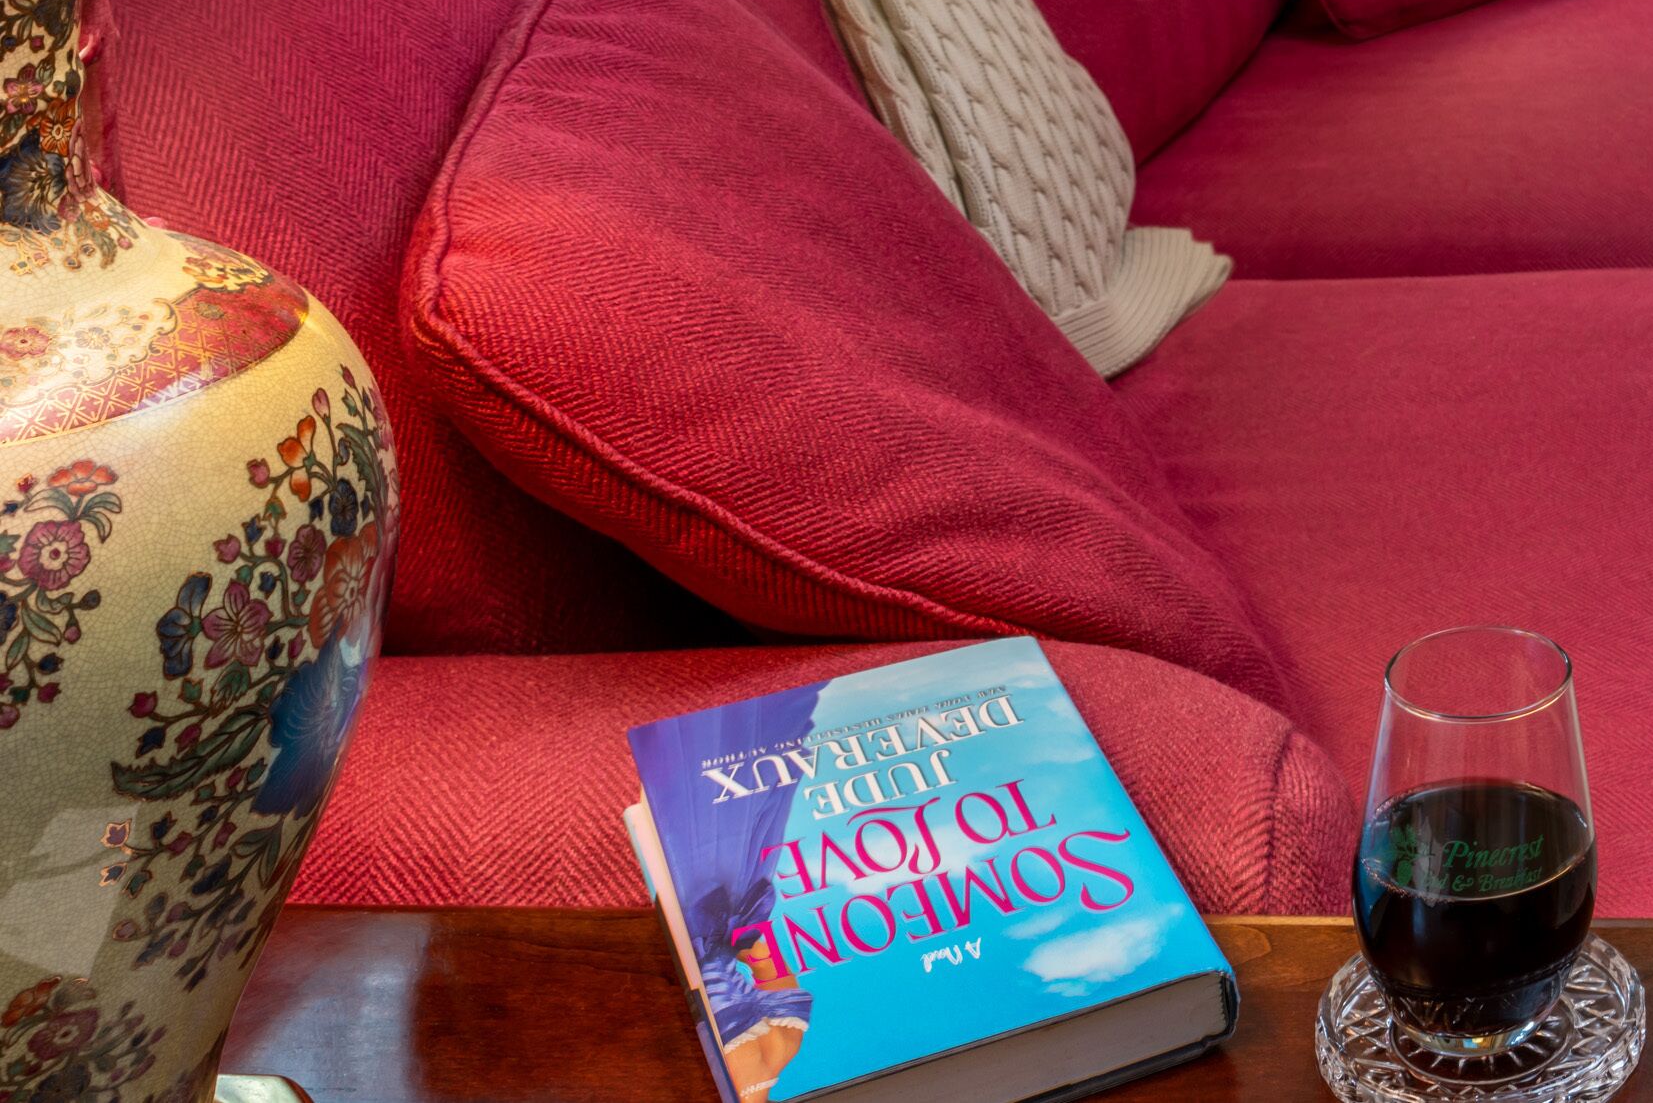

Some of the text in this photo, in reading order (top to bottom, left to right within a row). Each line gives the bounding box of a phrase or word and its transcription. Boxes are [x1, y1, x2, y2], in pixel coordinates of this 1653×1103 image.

[700, 694, 1024, 804] DEVERAUX
[701, 685, 1007, 770] NEW YORK TIMES BESTSELLING AUTHOR
[804, 749, 957, 820] JUDE
[762, 779, 1056, 899] TO LOVE
[1442, 834, 1544, 868] Pinecrest
[731, 828, 1134, 985] SOMEONE
[1452, 875, 1474, 892] &
[921, 938, 982, 973] A Novel
